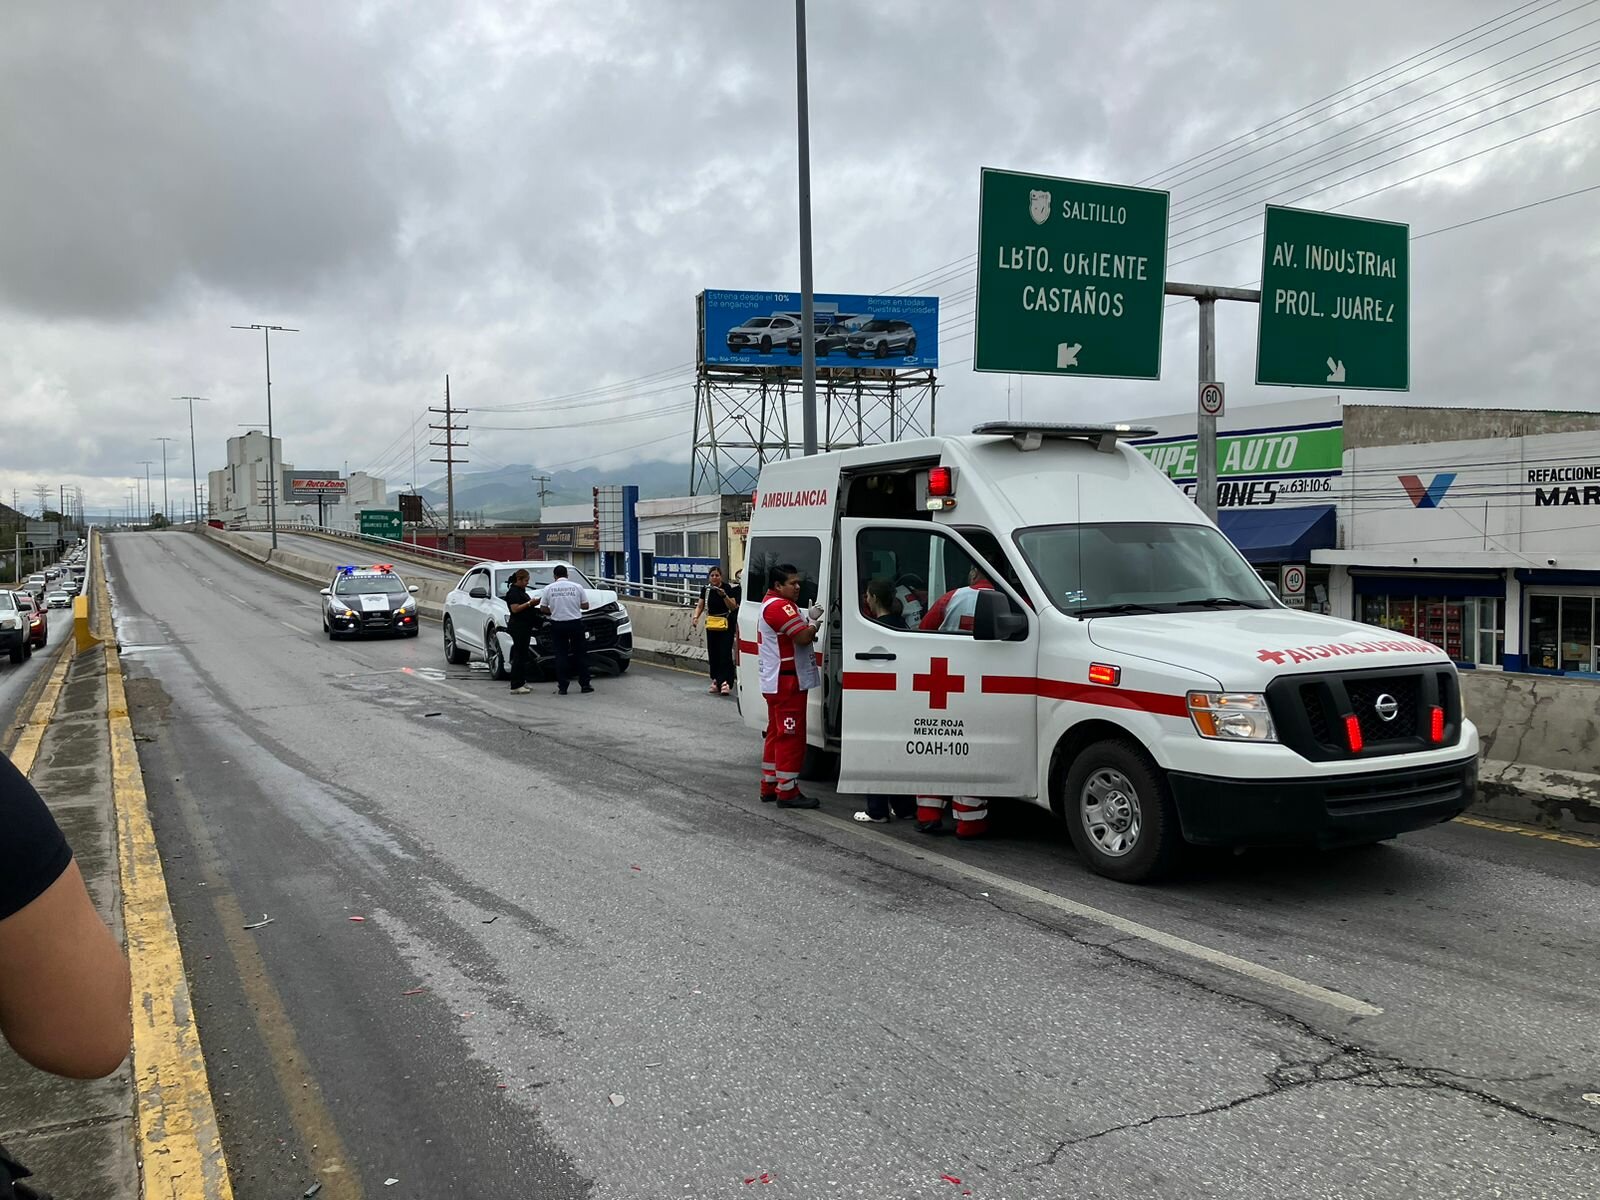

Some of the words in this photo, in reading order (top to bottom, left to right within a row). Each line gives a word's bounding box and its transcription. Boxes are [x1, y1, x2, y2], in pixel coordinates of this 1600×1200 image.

[1062, 200, 1127, 225] SALTILLO
[998, 245, 1054, 273] LBTO.
[1063, 252, 1149, 281] ORIENTE
[1272, 241, 1298, 268] AV.
[1305, 244, 1397, 279] INDUSTRIAL
[708, 291, 738, 300] Estrena
[740, 293, 764, 301] desde
[774, 293, 790, 302] 10%
[904, 298, 925, 307] todas
[1022, 285, 1124, 317] CASTAÑOS
[720, 300, 759, 310] enganche
[868, 305, 901, 313] nuestras
[1275, 288, 1325, 317] PROL.
[1331, 296, 1395, 323] JUAREZ
[1206, 389, 1218, 403] 60
[1222, 436, 1299, 472] AUTO
[761, 489, 827, 508] AMBULANCIA
[1535, 486, 1600, 506] MAR
[1289, 573, 1300, 584] 40
[913, 718, 939, 727] CRUZ
[940, 719, 965, 728] ROJA
[913, 727, 964, 737] MEXICANA
[906, 740, 969, 756] COAH-100
